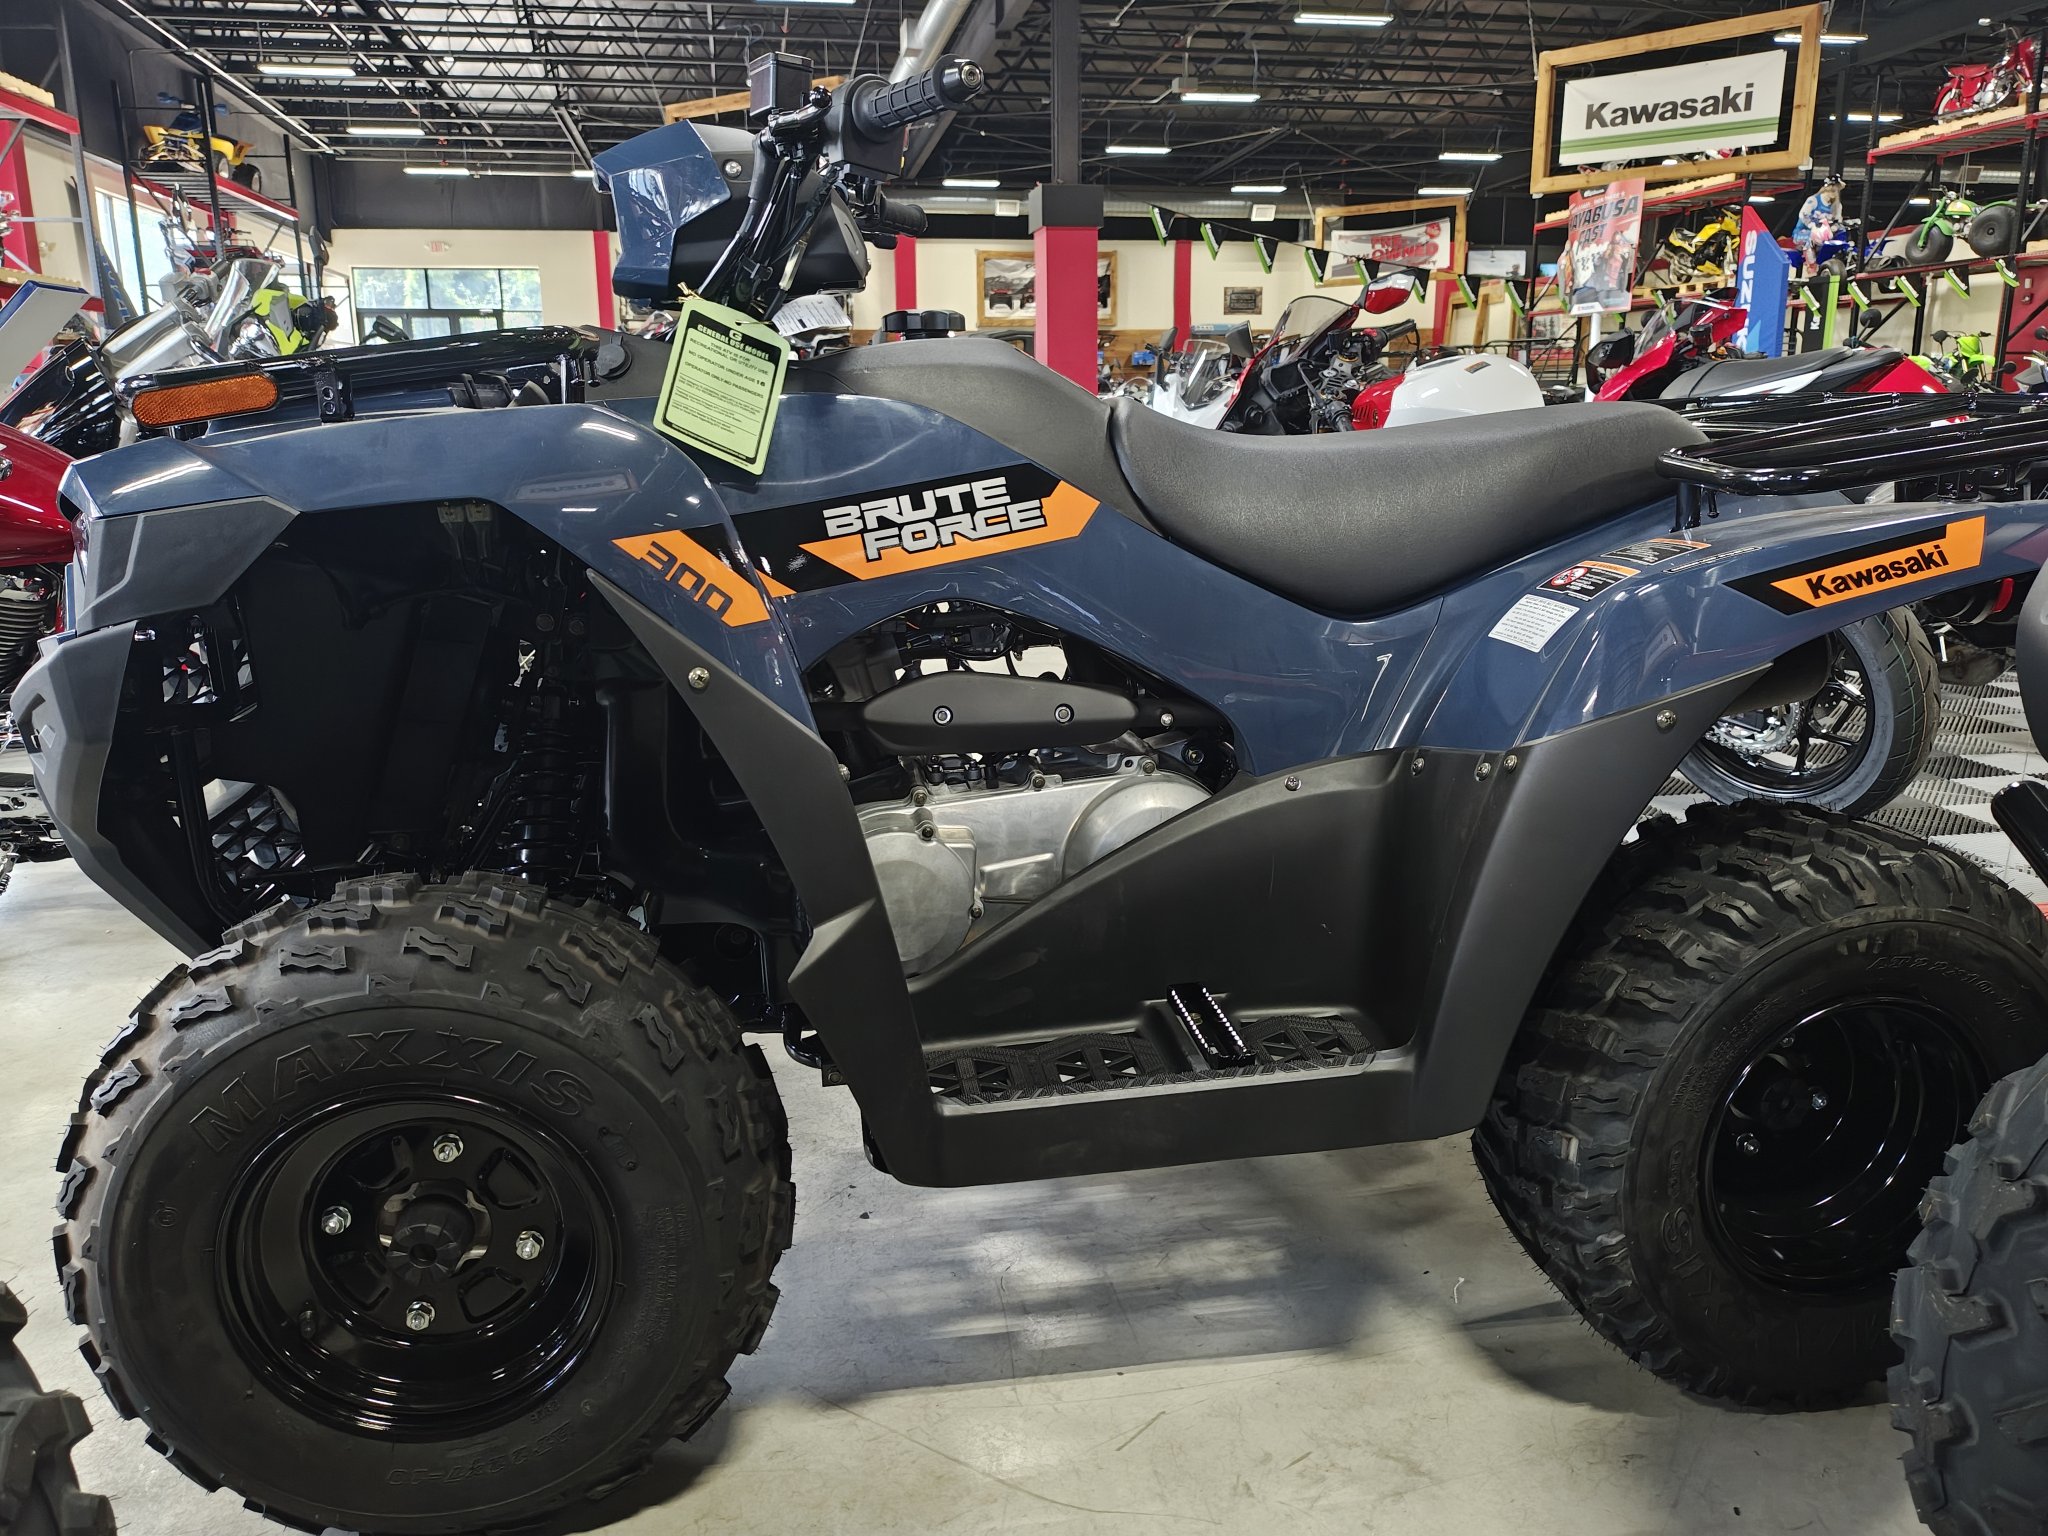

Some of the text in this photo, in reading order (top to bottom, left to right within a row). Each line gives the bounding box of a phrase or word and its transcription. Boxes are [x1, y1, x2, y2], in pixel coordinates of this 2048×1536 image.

[1585, 82, 1755, 130] Kawasaki
[1371, 241, 1439, 262] OWNED
[1736, 230, 1757, 353] SUZK
[689, 337, 729, 360] RECREATIONAL
[738, 359, 757, 371] UTILITY
[697, 324, 769, 360] GENERAL USE MODEL
[684, 361, 711, 376] OPERATOR
[732, 382, 764, 399] PASSENGERS
[697, 354, 725, 371] OPERATOR
[725, 367, 744, 378] UNDER
[756, 379, 766, 387] 16
[823, 477, 1011, 537] BRUTE
[861, 499, 1047, 562] FORCE
[637, 539, 734, 615] 300
[1805, 545, 1949, 599] Kawasaki
[189, 1026, 595, 1153] MAXXIS
